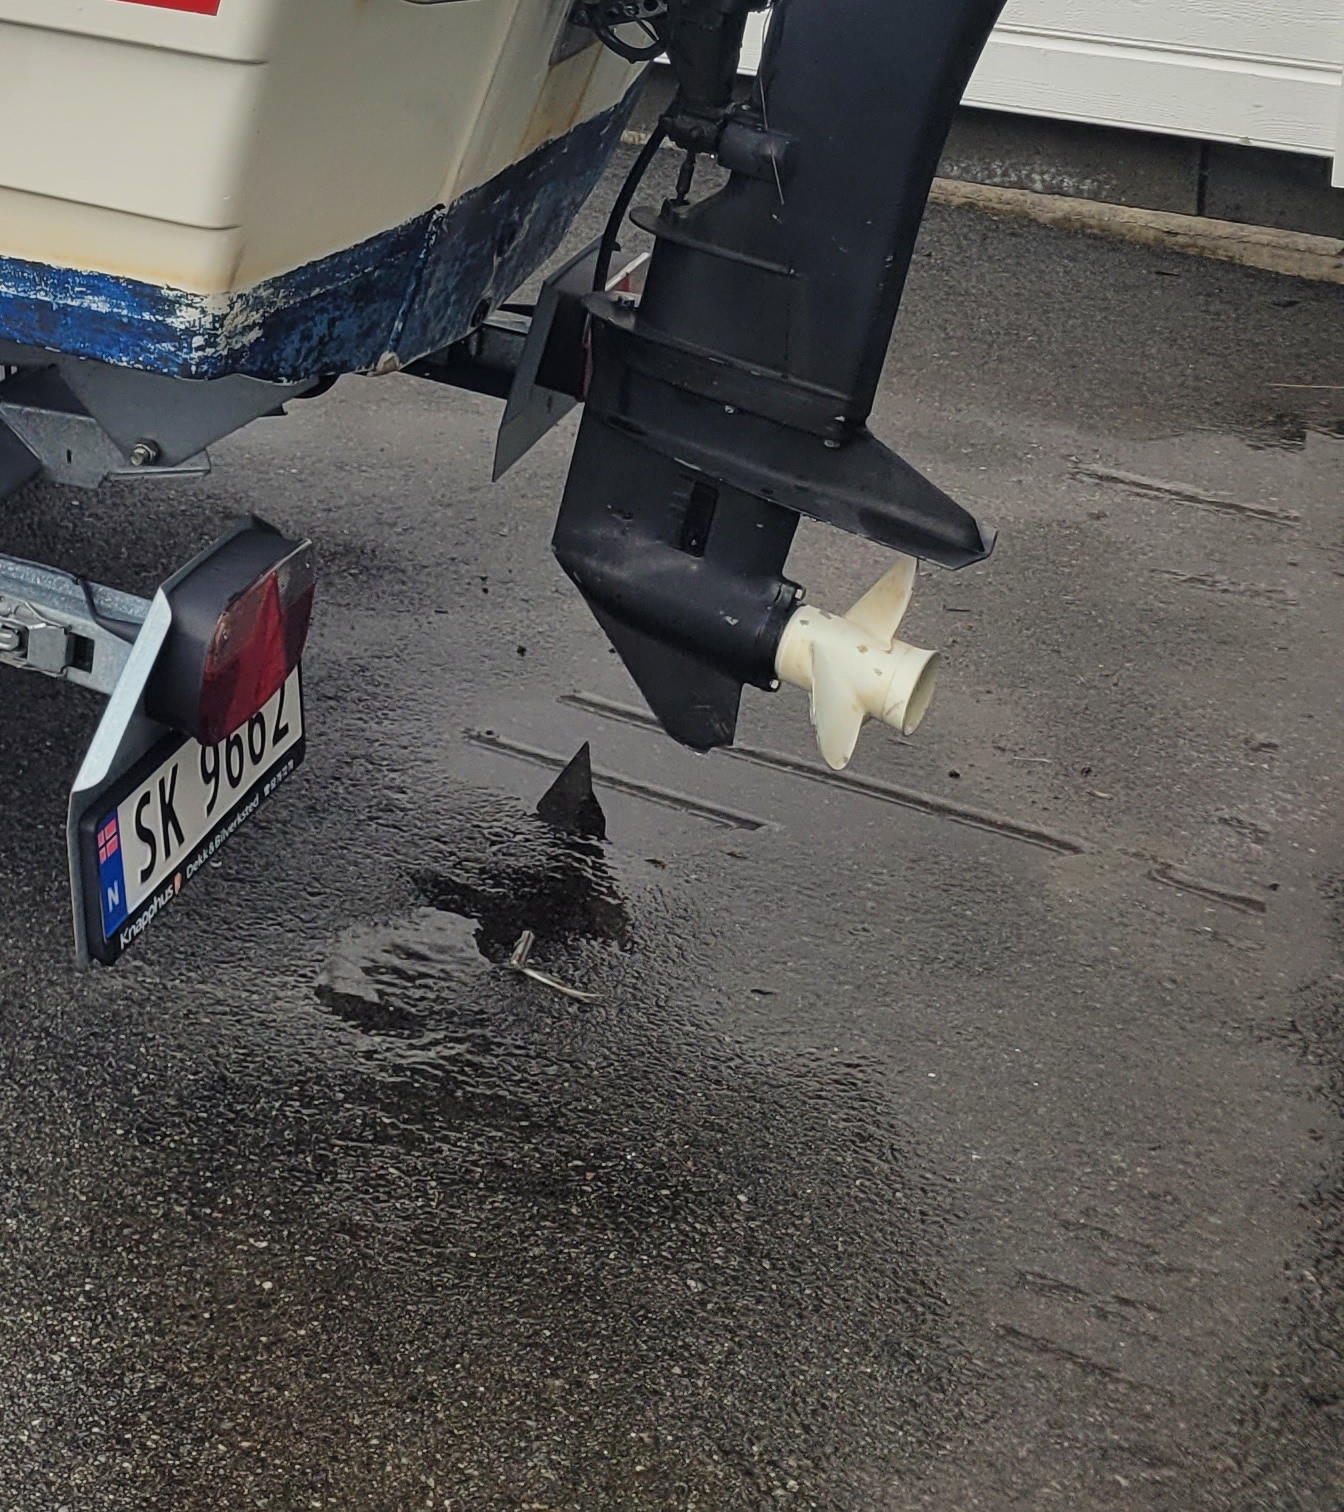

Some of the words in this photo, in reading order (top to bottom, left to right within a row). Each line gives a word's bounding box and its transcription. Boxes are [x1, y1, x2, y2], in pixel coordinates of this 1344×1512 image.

[119, 883, 174, 950] Knapphus
[185, 846, 209, 879] Dekk
[214, 792, 260, 849] Bilverksted
[134, 764, 184, 884] SK
[107, 880, 120, 913] N
